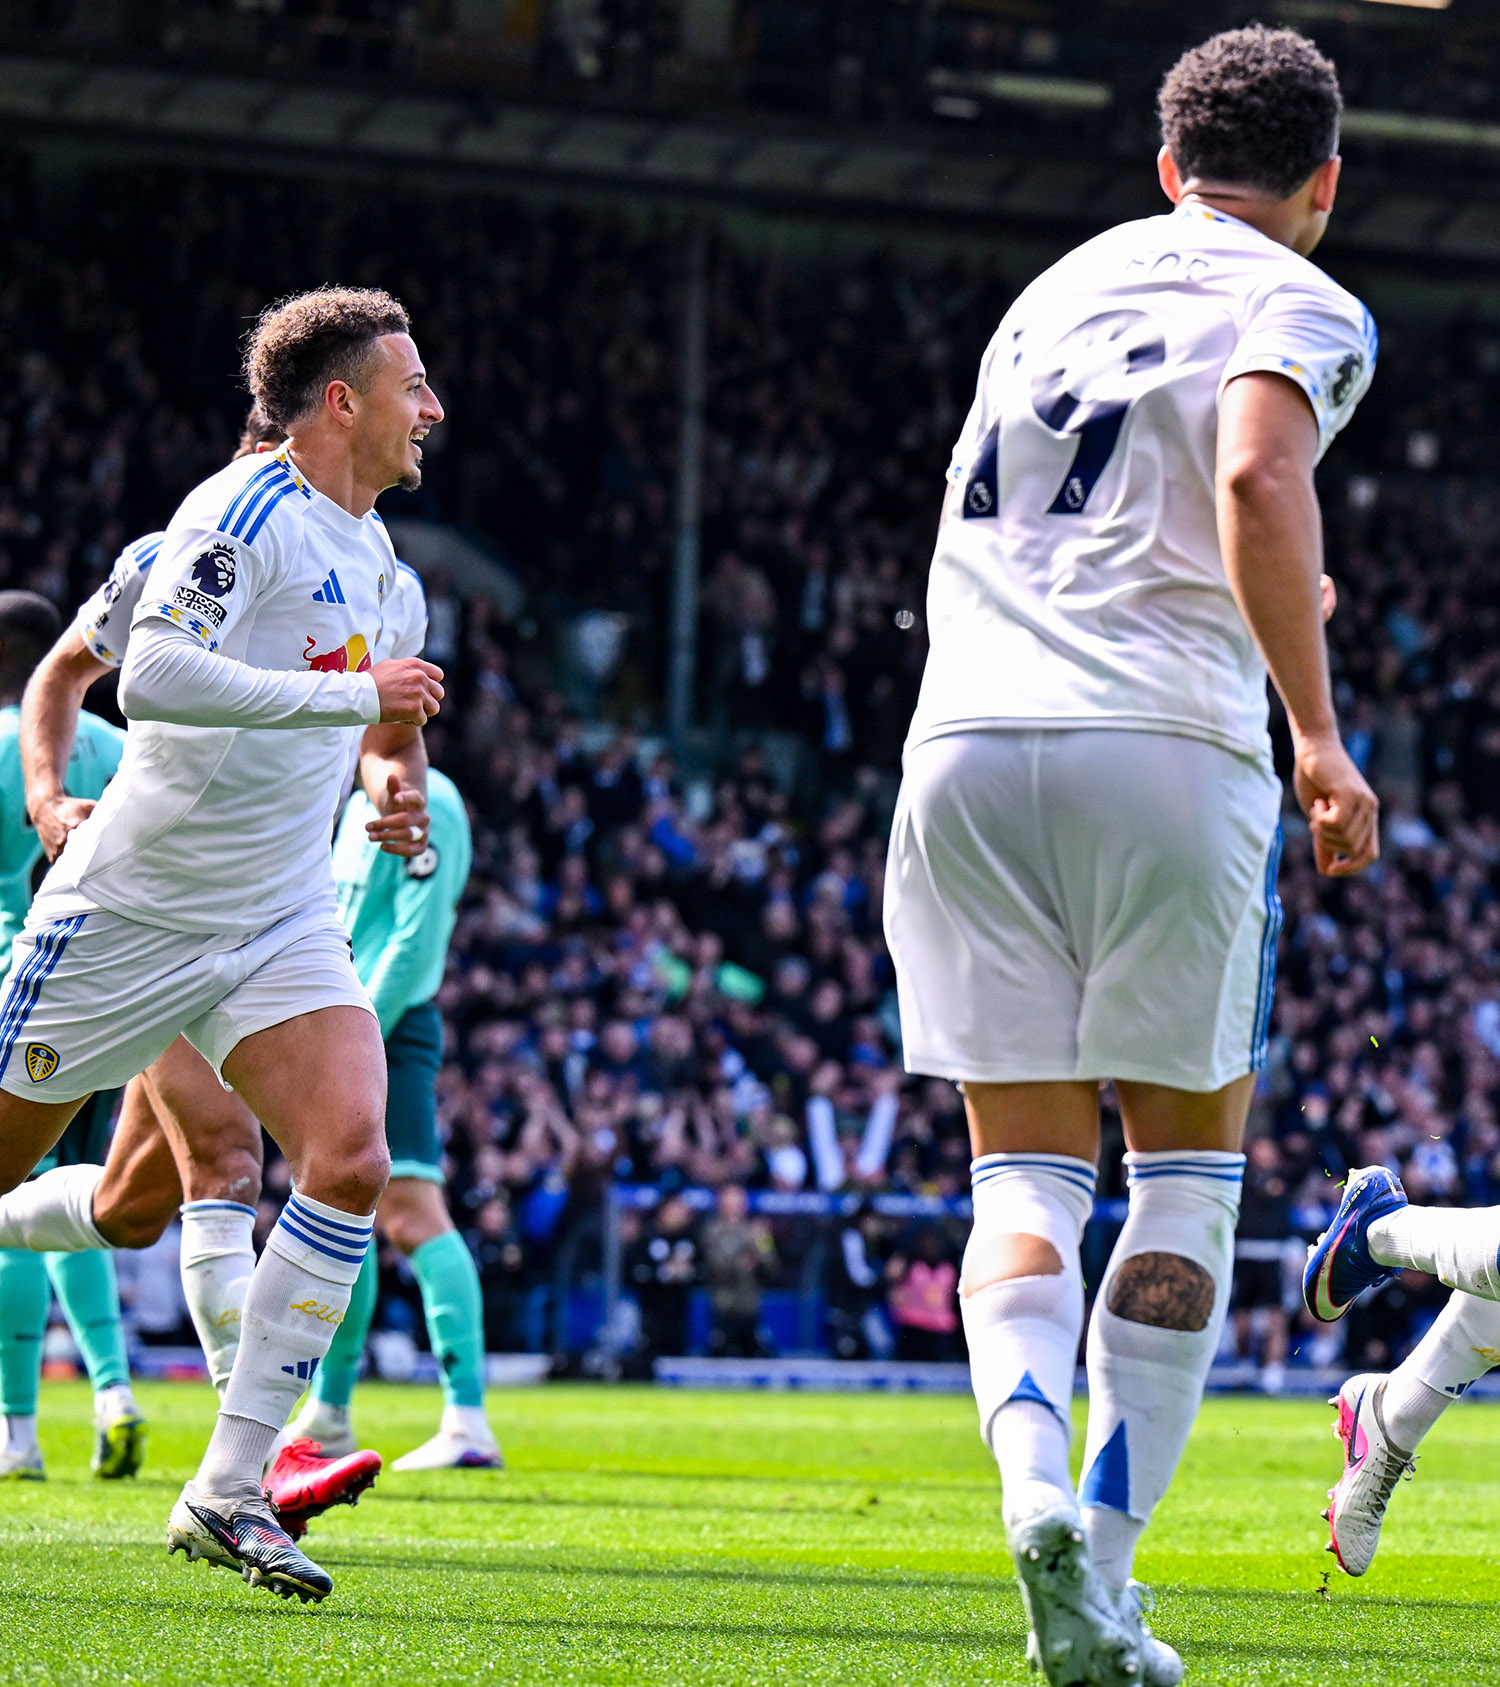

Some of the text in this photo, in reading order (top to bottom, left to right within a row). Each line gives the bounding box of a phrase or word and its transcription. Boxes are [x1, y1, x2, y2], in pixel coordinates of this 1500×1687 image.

[962, 308, 1166, 519] 19
[176, 586, 223, 619] No room
